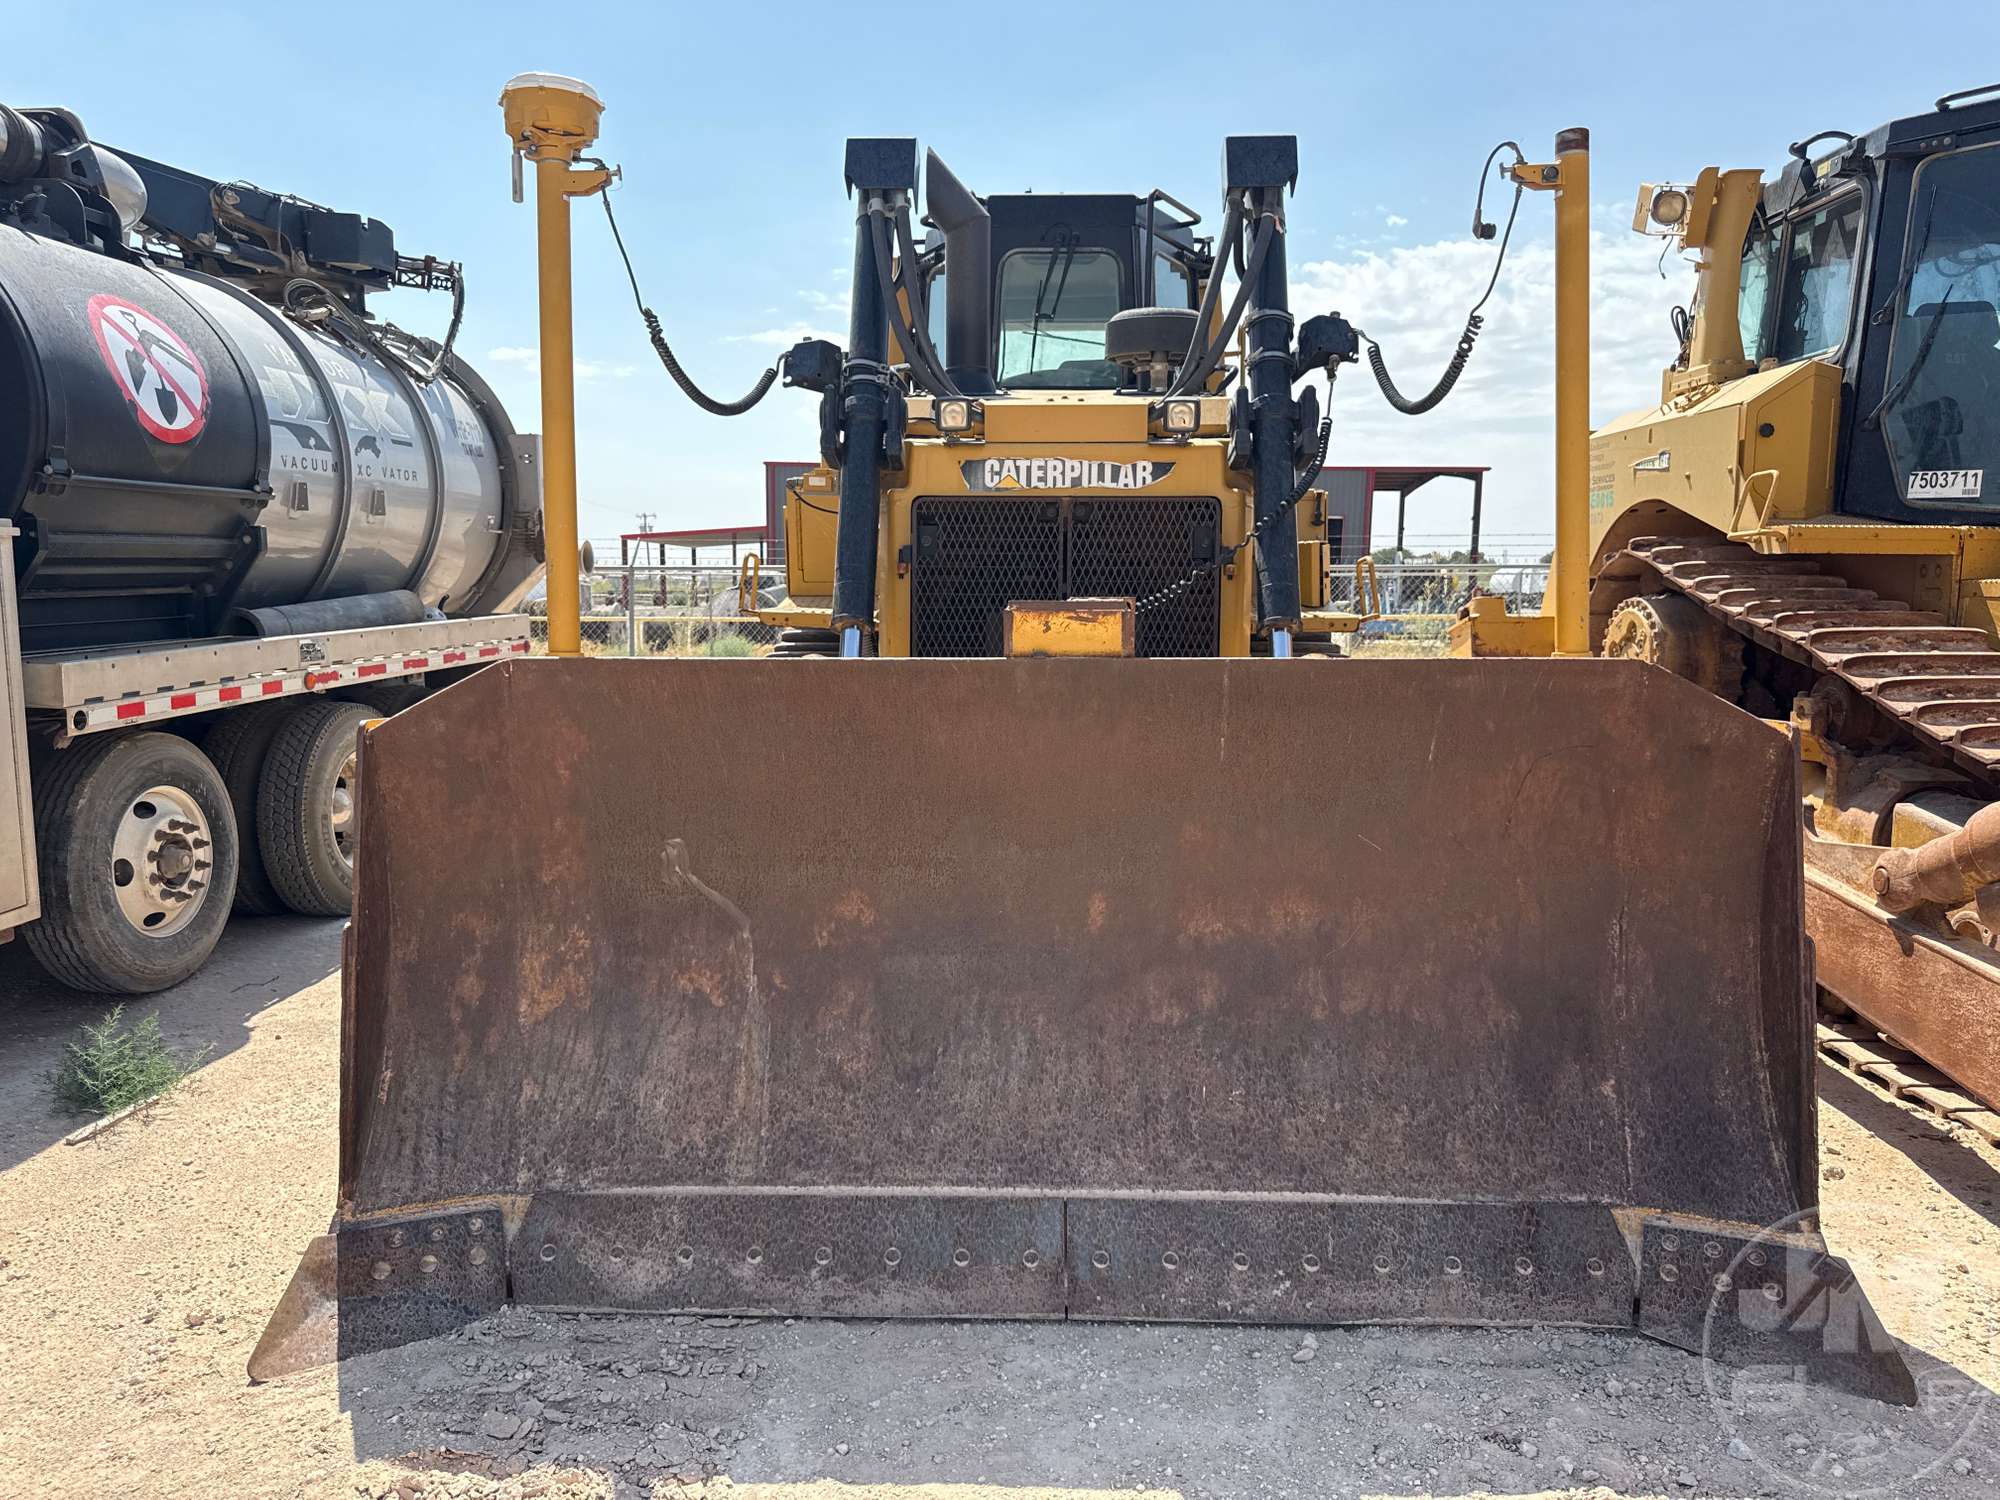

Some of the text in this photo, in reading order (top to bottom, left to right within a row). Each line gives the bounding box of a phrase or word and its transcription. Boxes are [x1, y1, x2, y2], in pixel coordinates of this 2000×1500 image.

[281, 455, 340, 473] VACUUM
[984, 458, 1154, 490] CATERPILLAR
[1910, 471, 1979, 489] 7503711
